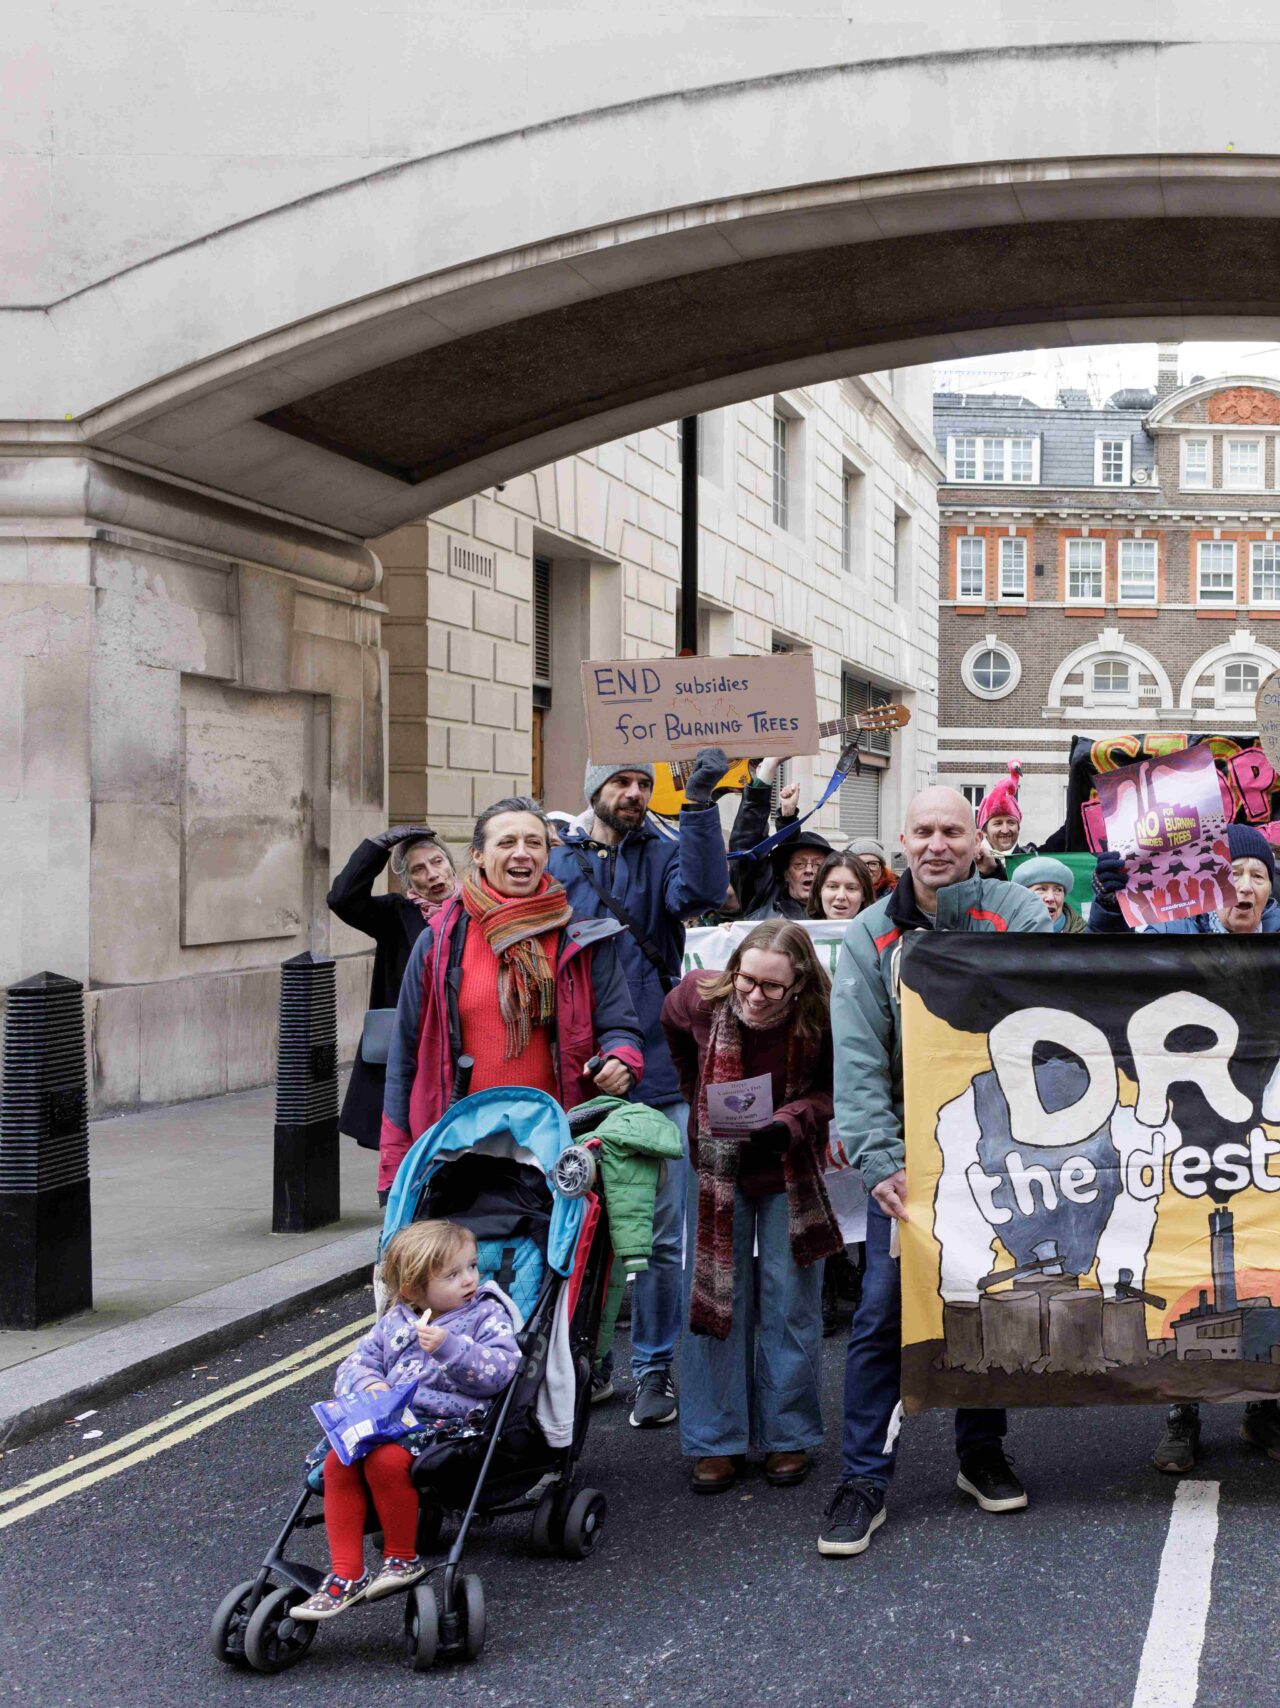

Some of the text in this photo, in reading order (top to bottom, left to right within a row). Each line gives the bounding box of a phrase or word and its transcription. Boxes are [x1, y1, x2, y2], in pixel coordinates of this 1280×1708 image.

[594, 667, 750, 696] END subsidies
[615, 713, 657, 744] for
[1136, 811, 1160, 838] NO
[1164, 817, 1197, 831] BURNING
[1167, 830, 1192, 847] TREES
[967, 1152, 1099, 1224] the
